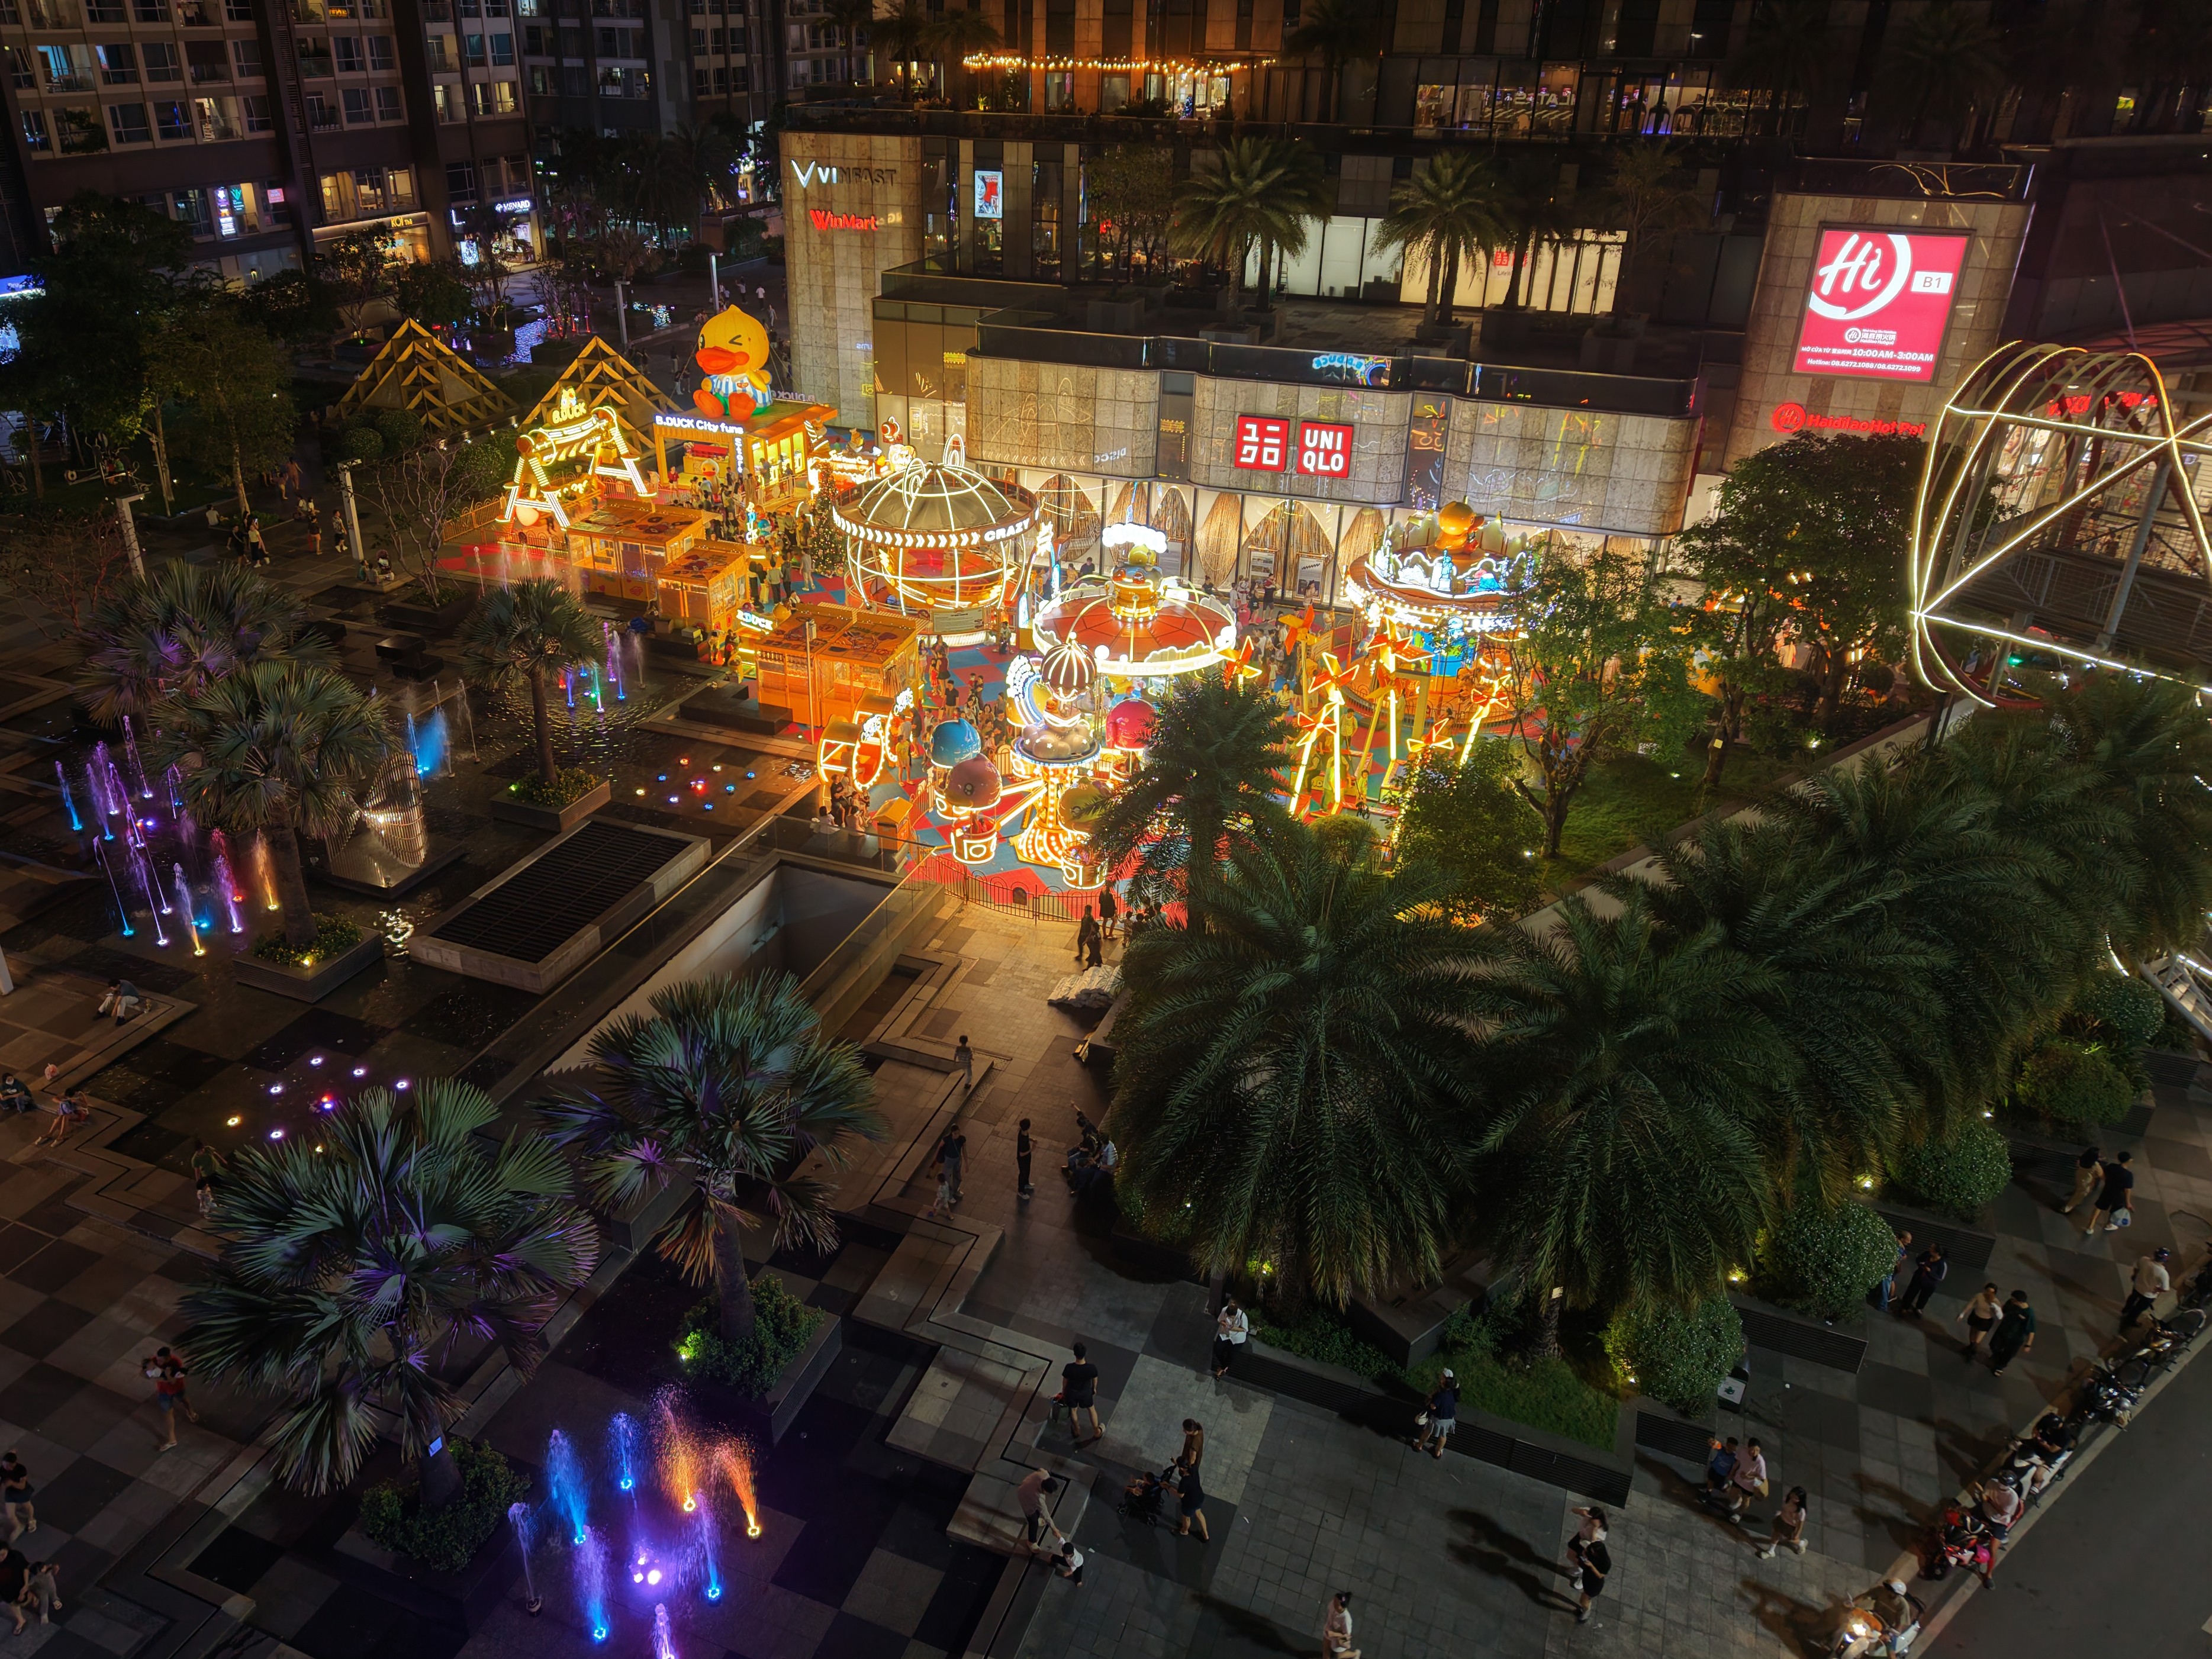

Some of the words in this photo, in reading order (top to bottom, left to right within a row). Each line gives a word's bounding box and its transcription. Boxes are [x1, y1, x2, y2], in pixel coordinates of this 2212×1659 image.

[817, 166, 896, 186] VINFAST
[391, 217, 404, 228] KOI
[809, 208, 878, 231] WinMart
[1819, 234, 1882, 295] Hi
[1923, 276, 1941, 289] B1
[552, 402, 587, 424] B.DUCK
[655, 415, 695, 429] B.DUCK
[696, 420, 719, 433] City
[719, 422, 744, 434] funs
[1807, 413, 1869, 430] Haidilao
[1869, 419, 1898, 434] Hot
[1898, 421, 1927, 436] Pot
[1305, 429, 1343, 451] UNI
[1303, 450, 1344, 472] QLO
[984, 517, 1030, 542] CRAZY
